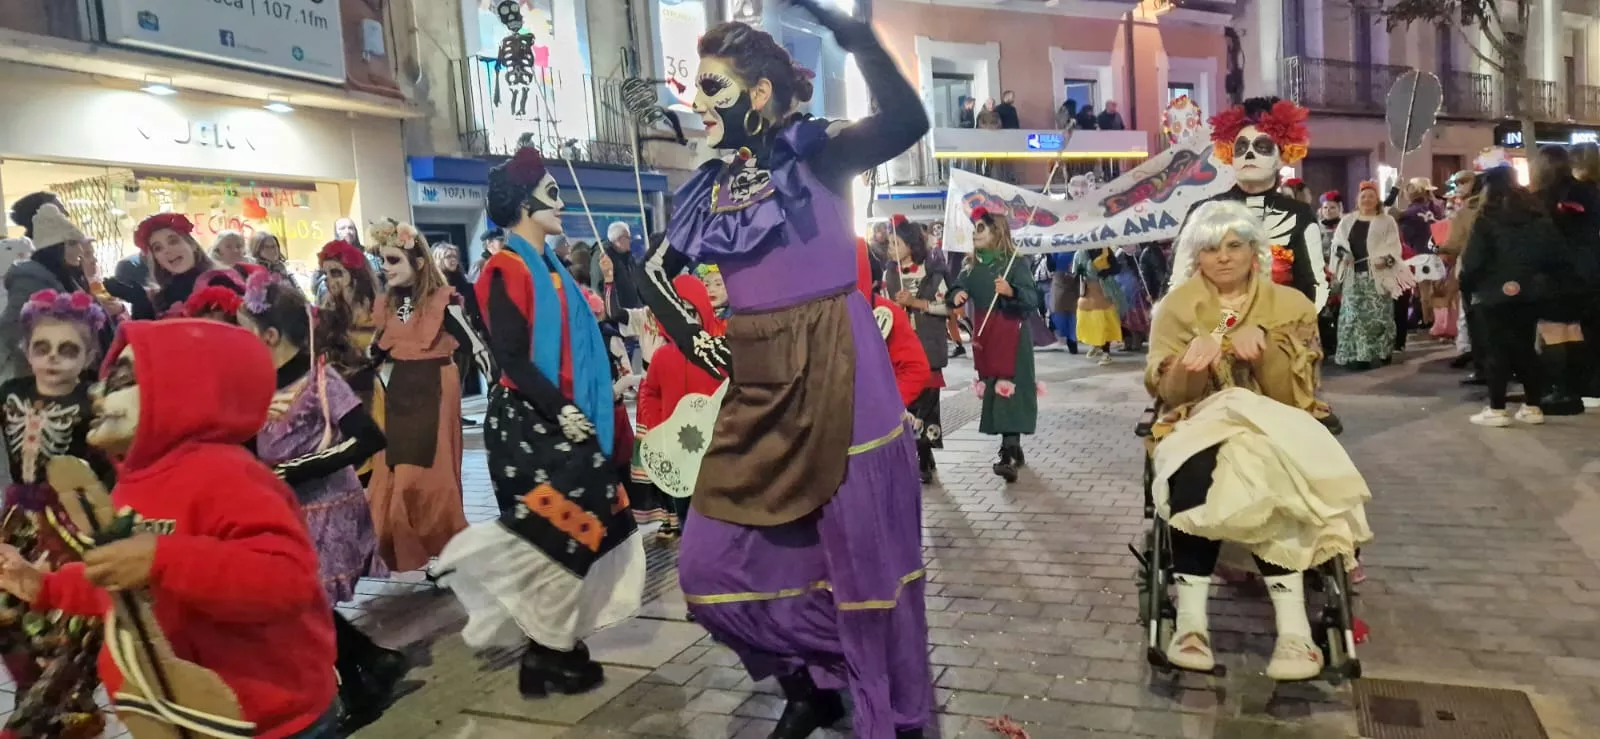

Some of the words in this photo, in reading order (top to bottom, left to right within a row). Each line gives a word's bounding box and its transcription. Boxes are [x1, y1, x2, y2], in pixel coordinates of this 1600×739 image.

[666, 55, 689, 78] 36
[1051, 223, 1118, 246] SANTA
[1123, 209, 1179, 236] ANA
